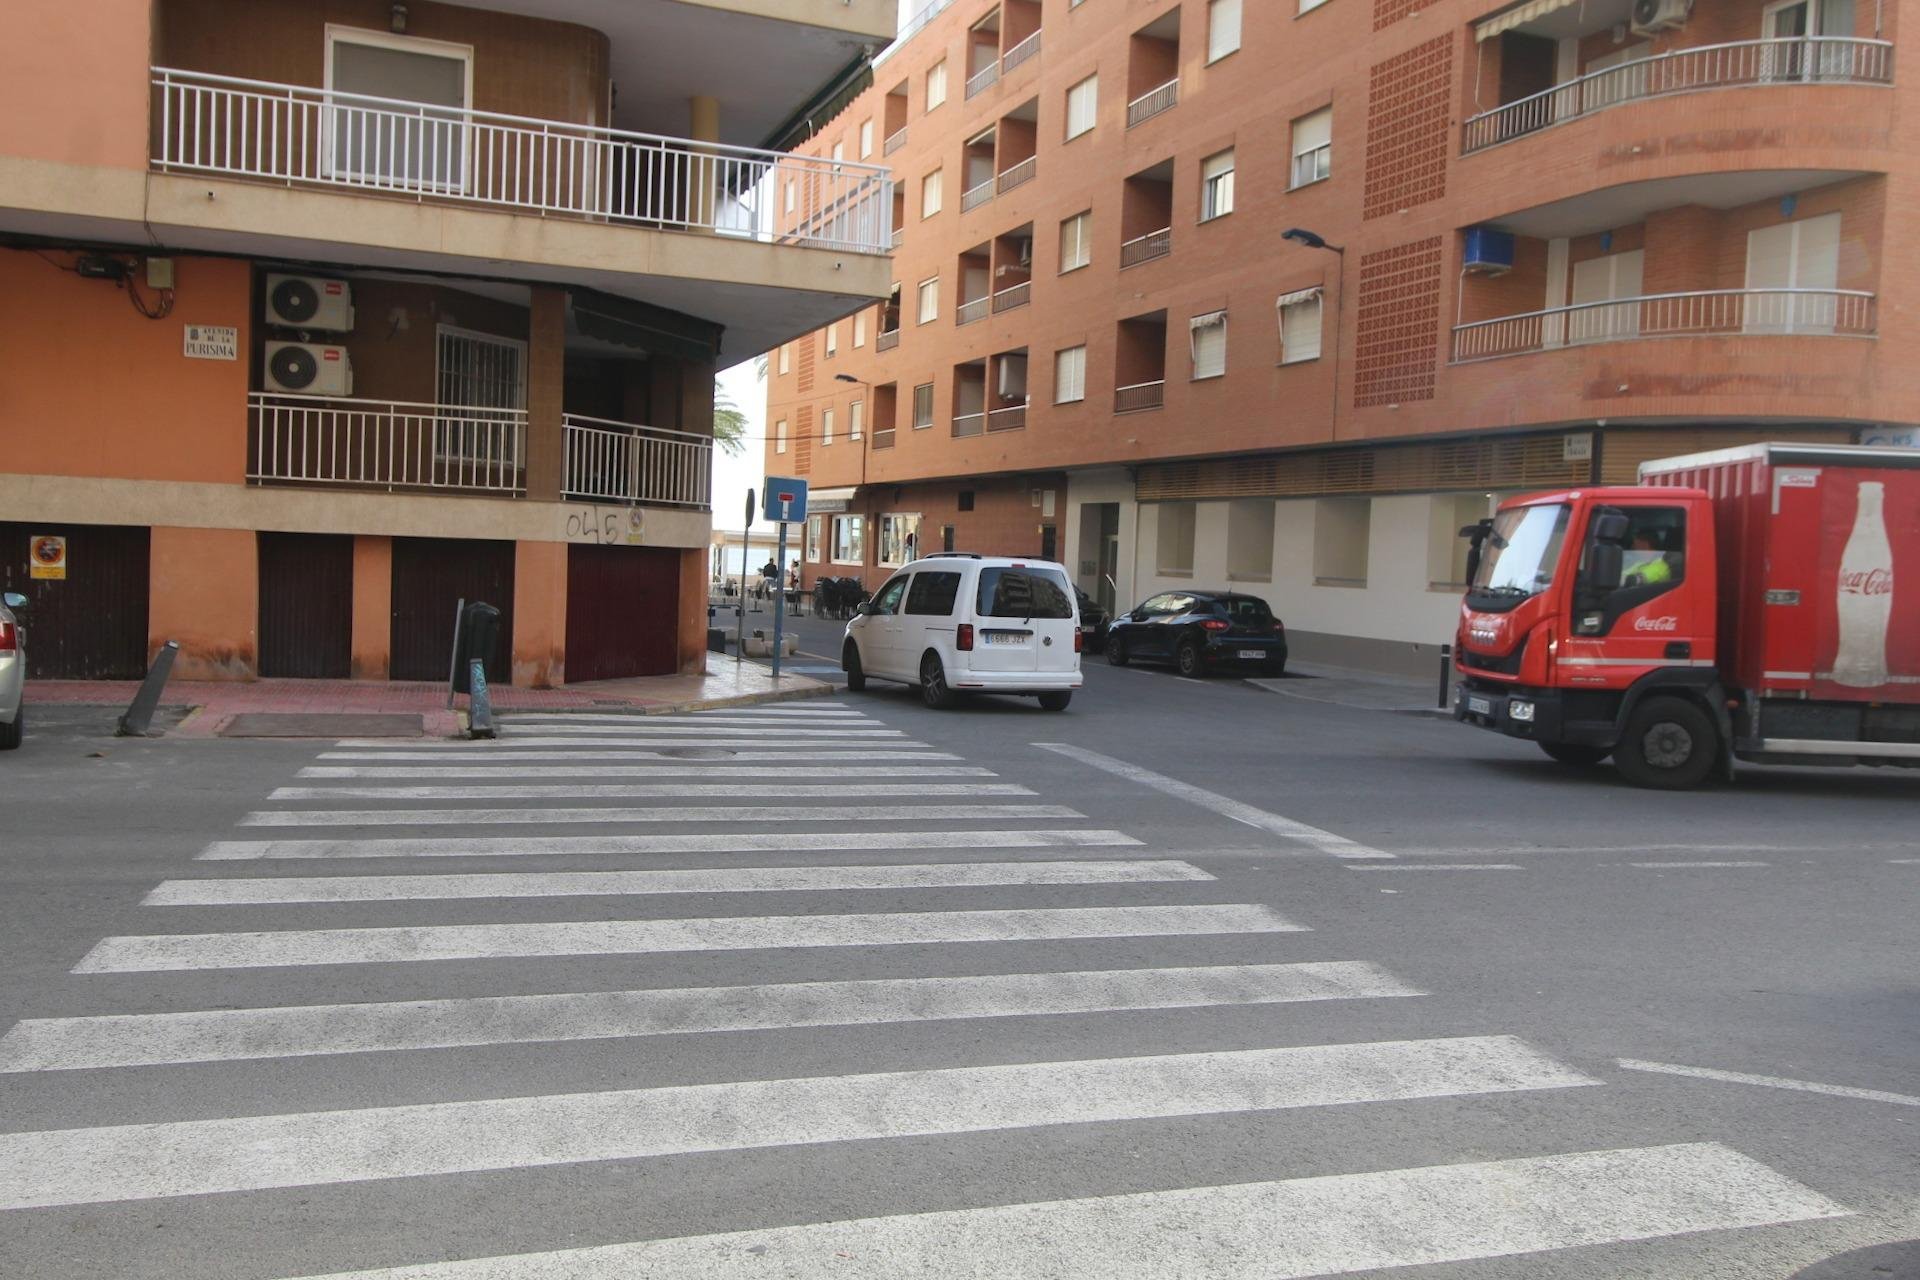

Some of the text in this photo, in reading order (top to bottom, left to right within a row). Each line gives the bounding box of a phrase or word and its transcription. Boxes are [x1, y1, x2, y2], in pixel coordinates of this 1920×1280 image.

[186, 343, 235, 357] PURISIMA
[566, 504, 618, 545] 045
[1634, 616, 1677, 631] Coca-Cola
